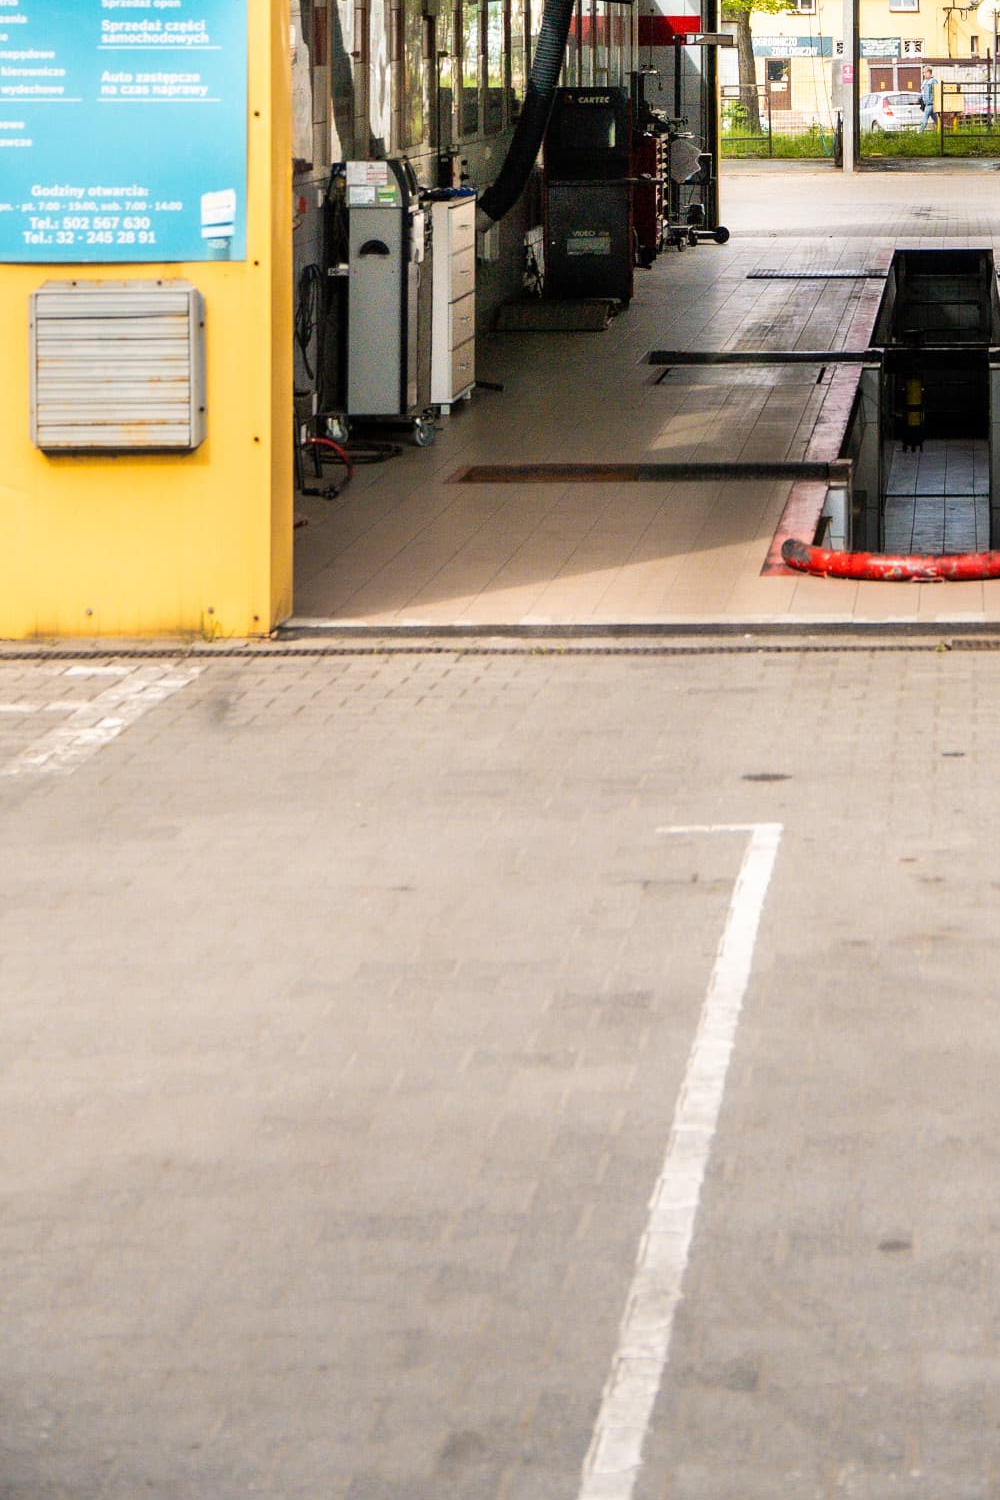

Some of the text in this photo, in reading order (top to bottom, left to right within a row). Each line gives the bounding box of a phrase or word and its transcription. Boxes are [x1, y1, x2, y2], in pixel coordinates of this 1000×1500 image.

[101, 20, 162, 33] Sprzedaż
[101, 32, 209, 46] samochodowych
[101, 71, 132, 83] Auto
[101, 85, 117, 95] na
[31, 185, 85, 199] Godziny
[29, 216, 151, 230] Tel.: 502 567 630
[23, 231, 53, 244] Tel.:
[56, 231, 74, 244] 32
[87, 231, 113, 244] 245
[117, 231, 135, 244] 28
[138, 231, 156, 244] 91
